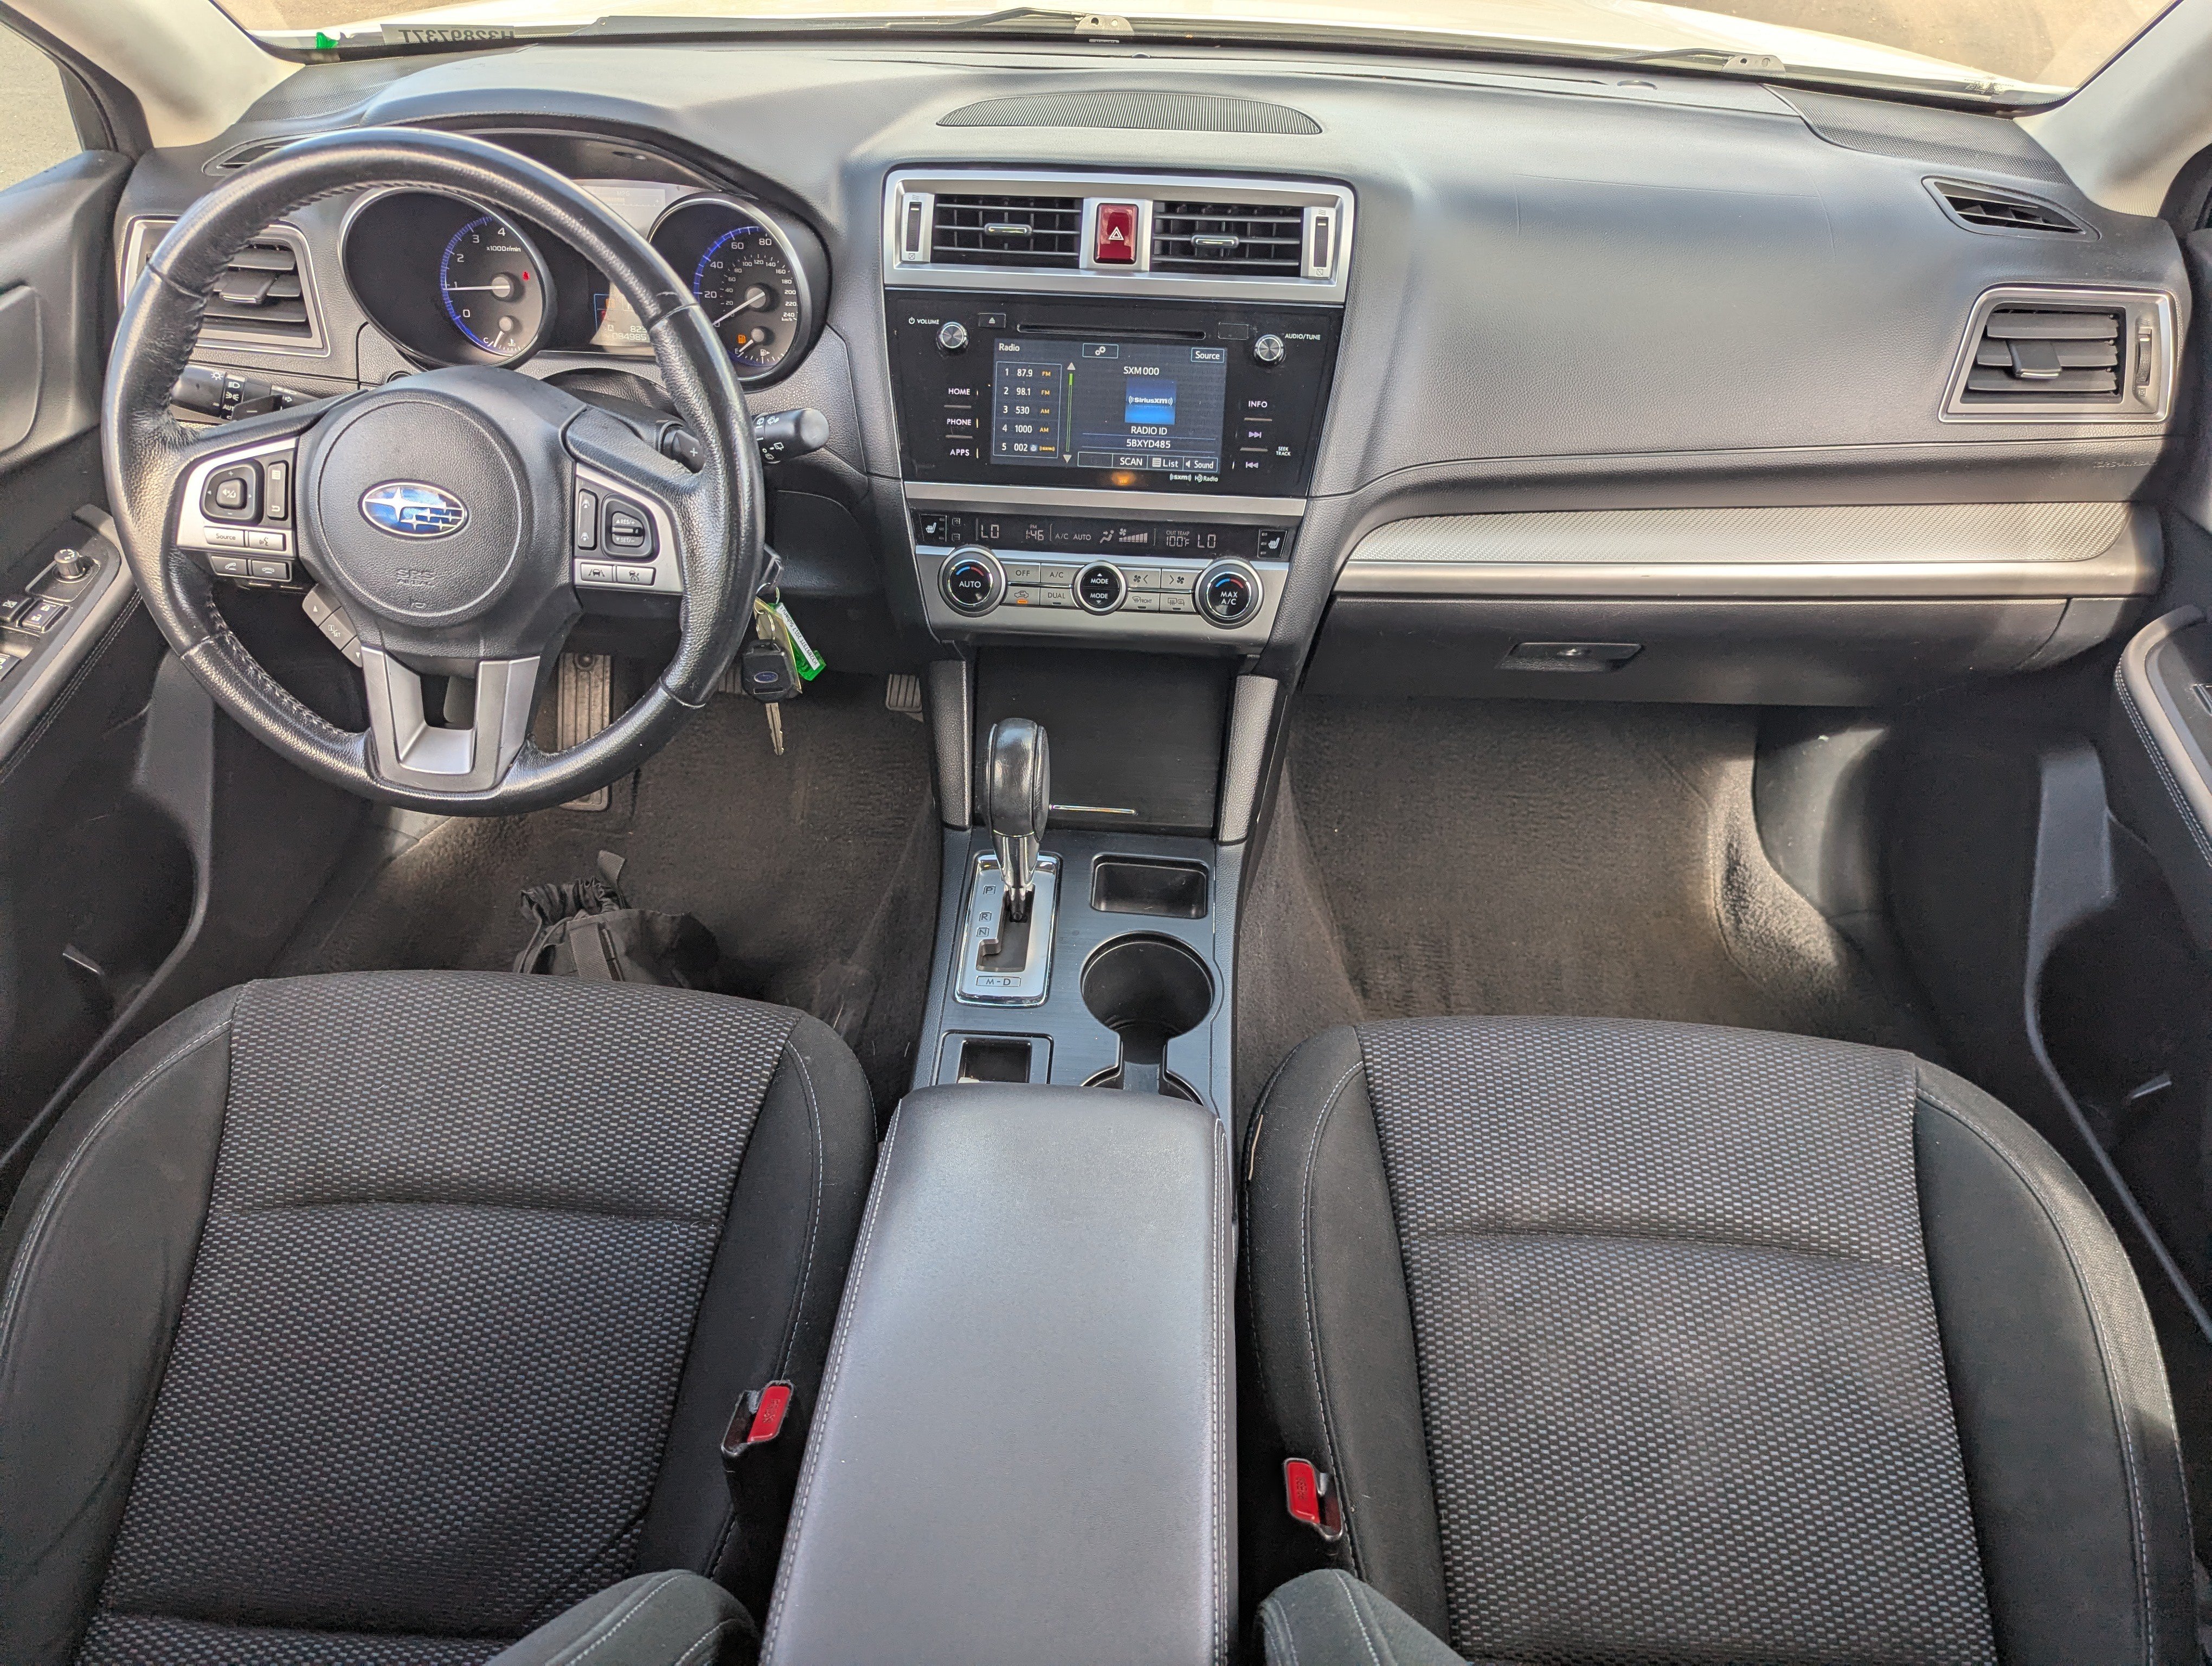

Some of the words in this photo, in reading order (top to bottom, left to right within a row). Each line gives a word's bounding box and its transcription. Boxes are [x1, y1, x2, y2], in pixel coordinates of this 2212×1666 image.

[498, 228, 505, 236] 4
[473, 235, 480, 244] 3
[456, 254, 464, 262] 2
[463, 309, 471, 317] 0
[999, 343, 1020, 352] Radio
[1195, 351, 1220, 360] Source
[1017, 369, 1033, 377] 87.9
[1123, 366, 1142, 375] SXM
[1143, 367, 1160, 375] 000
[1016, 388, 1031, 396] 98.1
[1248, 400, 1268, 408] INFO
[1015, 425, 1032, 433] 1000
[1131, 426, 1158, 435] RADIO
[1014, 444, 1028, 452] 002
[1126, 439, 1171, 448] 5BXYD485
[1120, 457, 1142, 466] SCAN
[1163, 459, 1179, 467] List
[1194, 460, 1214, 469] Sound
[981, 524, 999, 539] LO
[1026, 530, 1044, 541] 1:46
[1197, 534, 1216, 548] LO
[782, 609, 795, 627] Subaru
